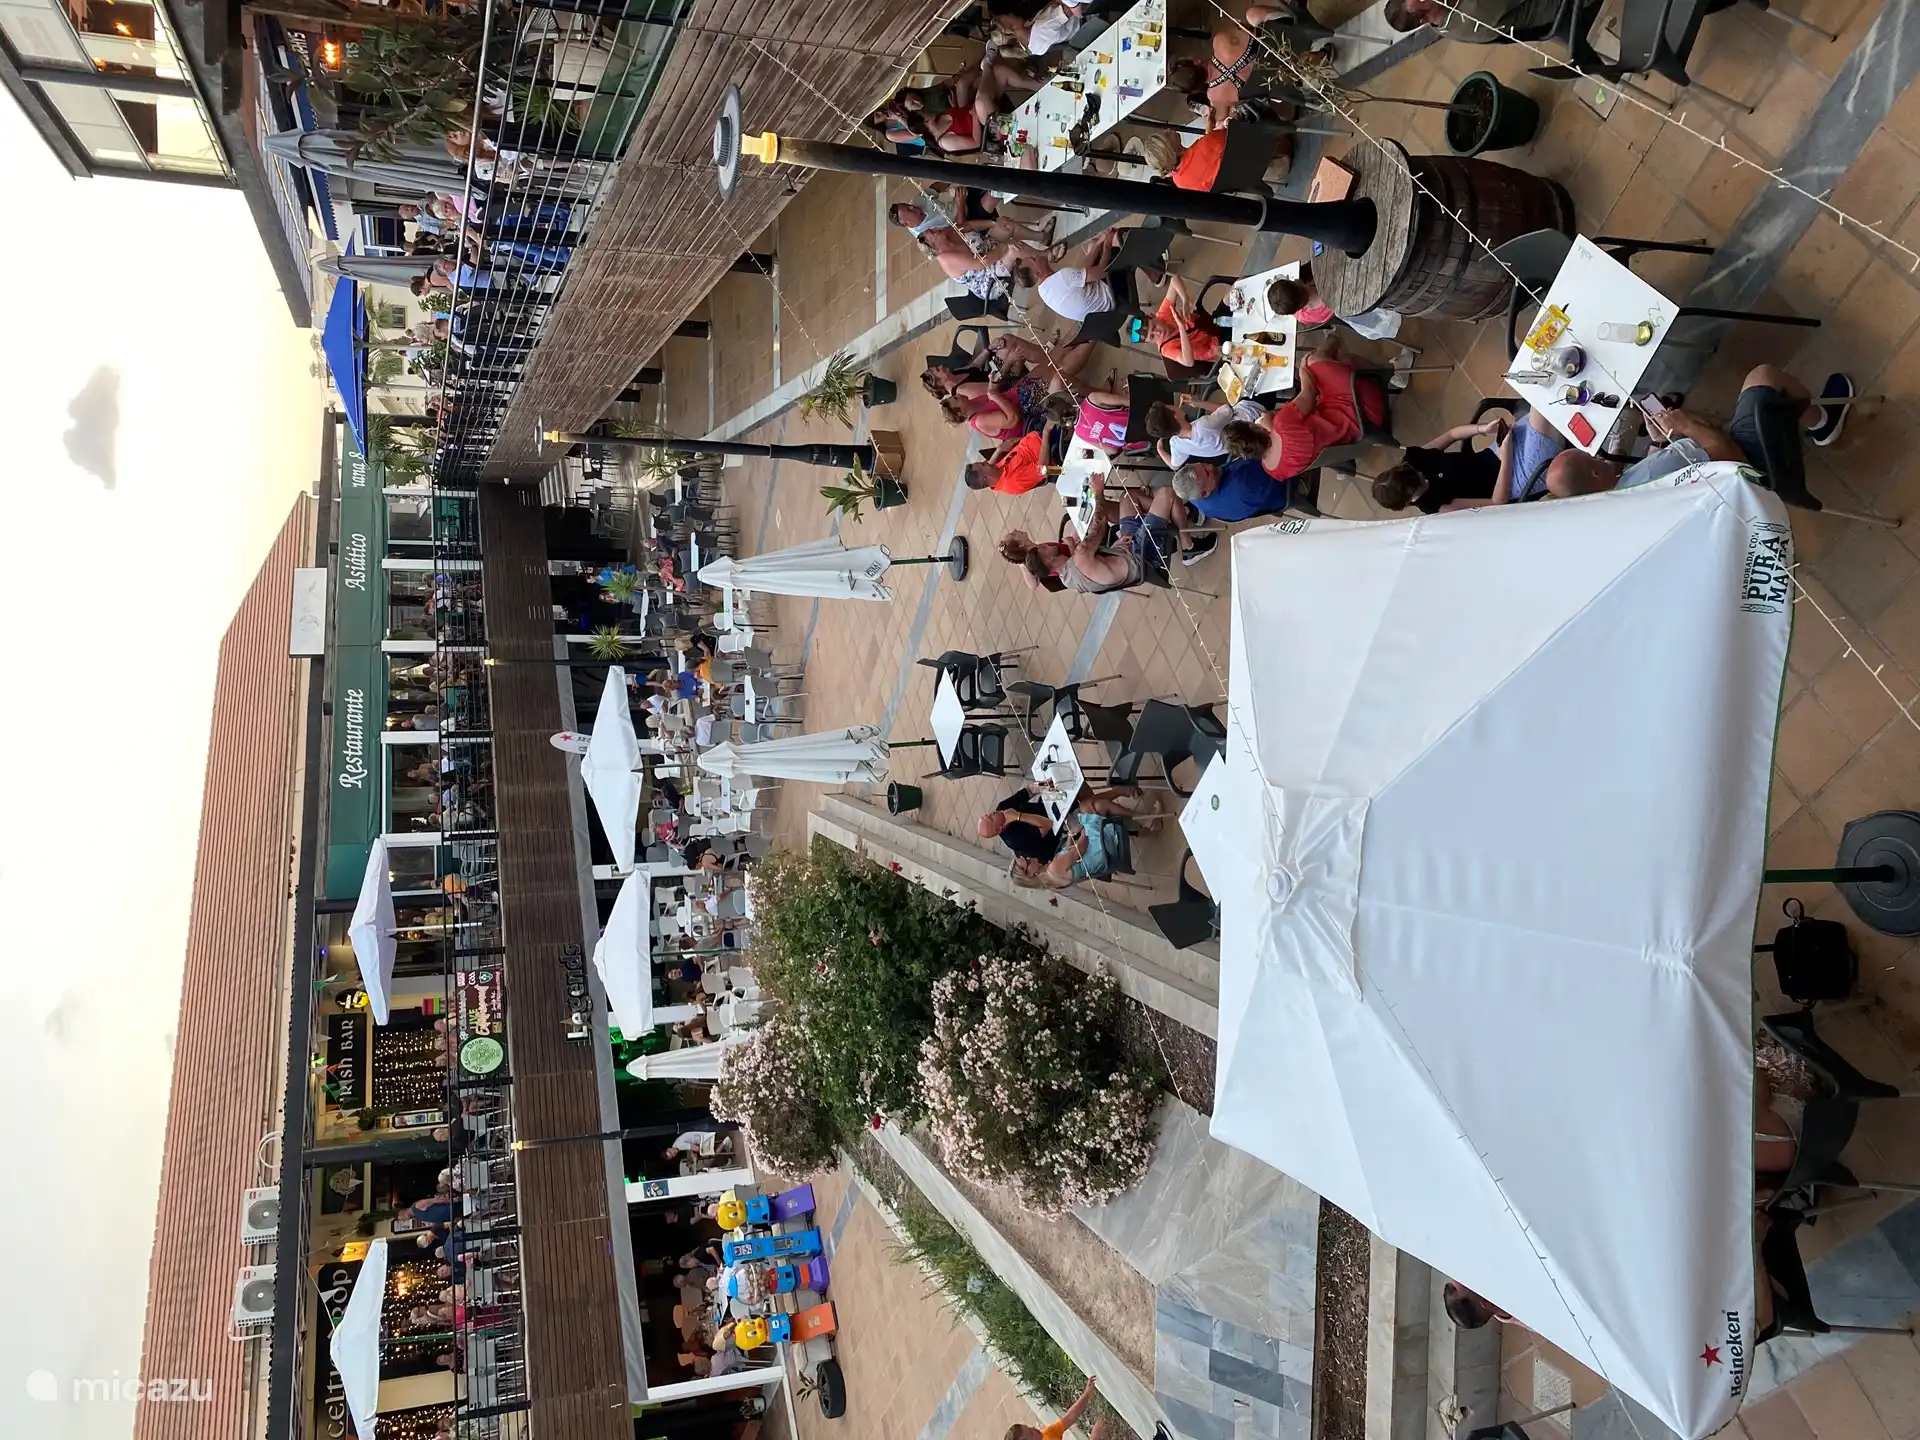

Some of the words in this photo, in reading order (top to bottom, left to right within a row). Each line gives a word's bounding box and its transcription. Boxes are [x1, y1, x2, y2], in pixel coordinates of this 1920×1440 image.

[1648, 300, 1666, 328] 52
[1102, 422, 1127, 446] 14
[344, 533, 367, 591] Asiático
[1741, 550, 1757, 600] ELABORADA
[338, 688, 368, 788] Restaurante
[559, 943, 592, 1039] Legends
[341, 1020, 354, 1050] BAR
[468, 1008, 478, 1030] LIVE
[1726, 1310, 1744, 1398] Heineken
